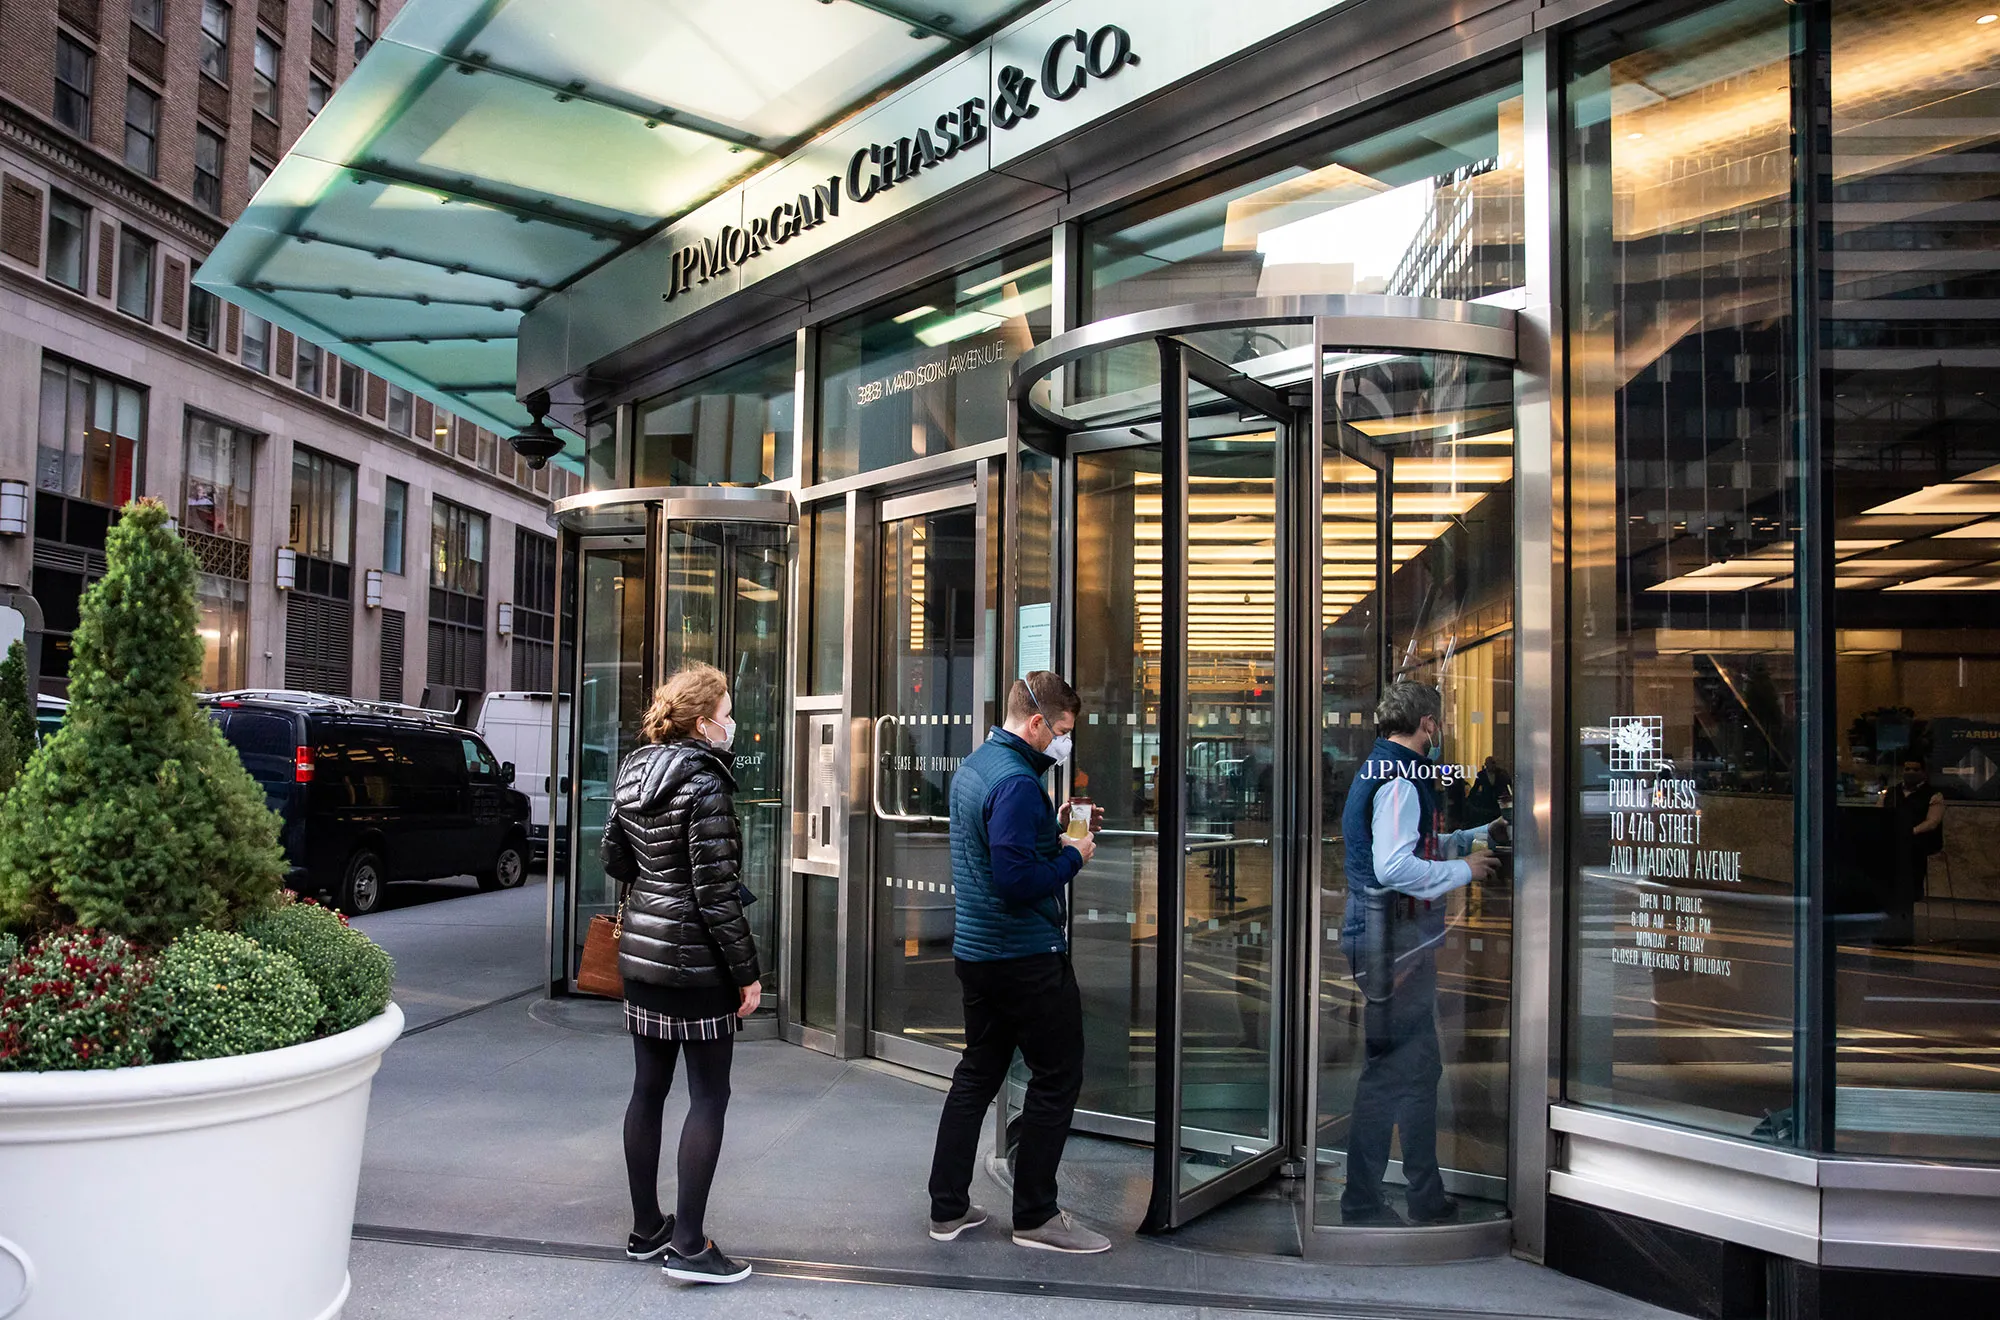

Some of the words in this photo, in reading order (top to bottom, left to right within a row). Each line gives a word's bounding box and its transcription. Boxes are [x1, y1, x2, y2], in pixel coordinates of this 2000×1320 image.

[662, 176, 841, 302] JPMORGAN
[846, 97, 988, 203] CHASE
[991, 65, 1039, 130] &
[1041, 24, 1141, 101] CO.
[857, 381, 883, 405] 383
[885, 359, 947, 397] MADISON
[948, 340, 1006, 376] AVENUE
[894, 755, 911, 771] LEASE
[915, 756, 926, 771] USE
[1360, 760, 1478, 786] J.P.Morgan
[1609, 778, 1647, 808] PUBLIC
[1653, 780, 1696, 811] ACCESS
[1609, 811, 1624, 841] TO
[1628, 813, 1654, 843] 47th
[1659, 814, 1701, 845] STREET
[1609, 846, 1633, 875] AND
[1637, 847, 1689, 879] MADISON
[1694, 851, 1741, 882] AVENUE
[1639, 893, 1658, 910] OPEN
[1663, 895, 1671, 911] TO
[1675, 896, 1703, 914] PUBLIC
[1631, 912, 1649, 928] 6:00
[1652, 914, 1664, 929] AM
[1676, 916, 1695, 932] 9:30
[1699, 918, 1711, 934] PM
[1636, 931, 1667, 949] MONDAY
[1678, 935, 1705, 953] FRIDAY
[1612, 947, 1638, 965] CLOSED
[1642, 951, 1680, 971] WEEKENDS
[1684, 955, 1689, 971] &
[1693, 958, 1731, 977] HOLIDAYS
